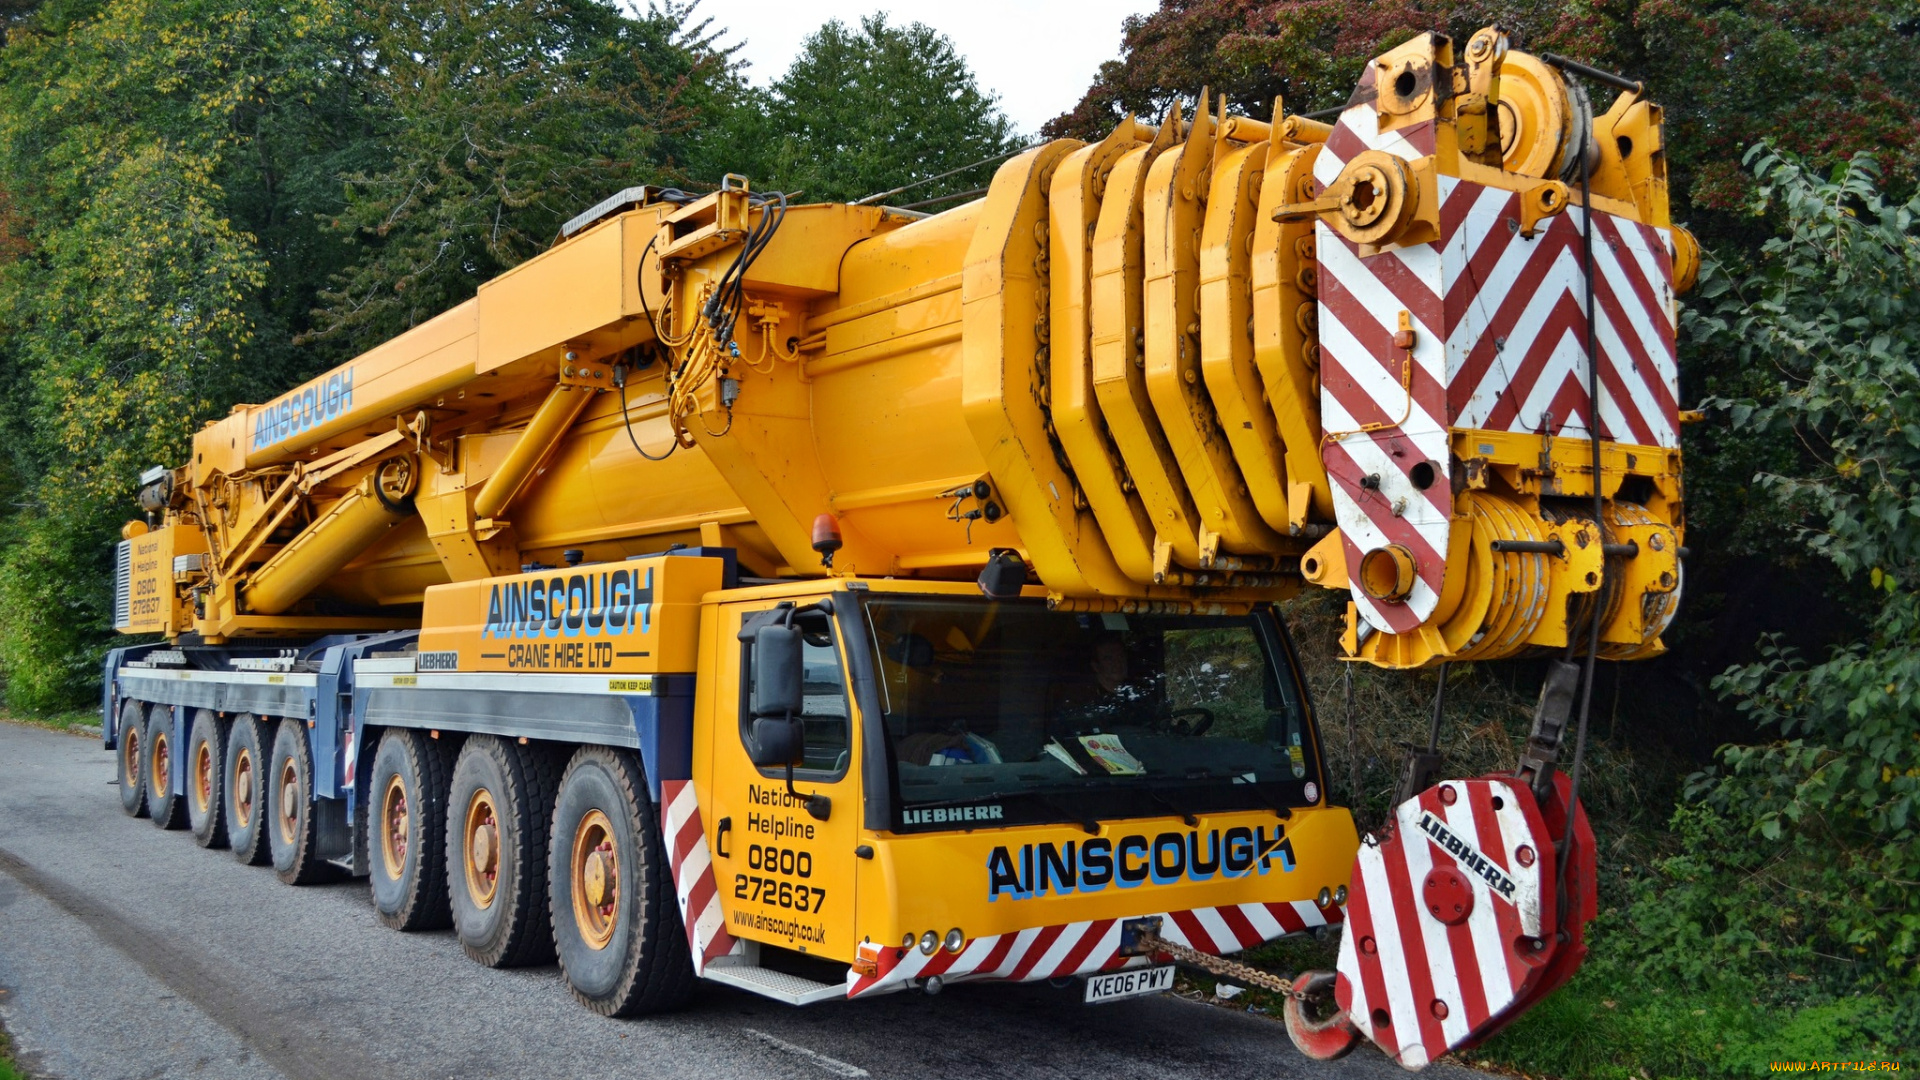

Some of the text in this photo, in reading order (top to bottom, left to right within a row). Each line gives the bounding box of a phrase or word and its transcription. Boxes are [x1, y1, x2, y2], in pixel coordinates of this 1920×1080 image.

[253, 366, 353, 452] AINSCOUGH
[137, 578, 157, 595] 0800
[132, 597, 160, 615] 272637
[482, 567, 654, 639] AINSCOUGH
[419, 652, 457, 670] LIEBHERR
[508, 642, 612, 668] CRANE HIRE LTD
[748, 784, 816, 809] Nation
[748, 812, 815, 840] Helpline
[903, 805, 1003, 824] LIEBHERR
[748, 844, 812, 878] 0800
[986, 824, 1296, 902] AINSCOUGH
[1420, 814, 1516, 899] LIEBHERR
[734, 873, 826, 914] 272637
[733, 909, 826, 944] www.ainscough.co.uk
[1093, 968, 1168, 998] KE06 PWY
